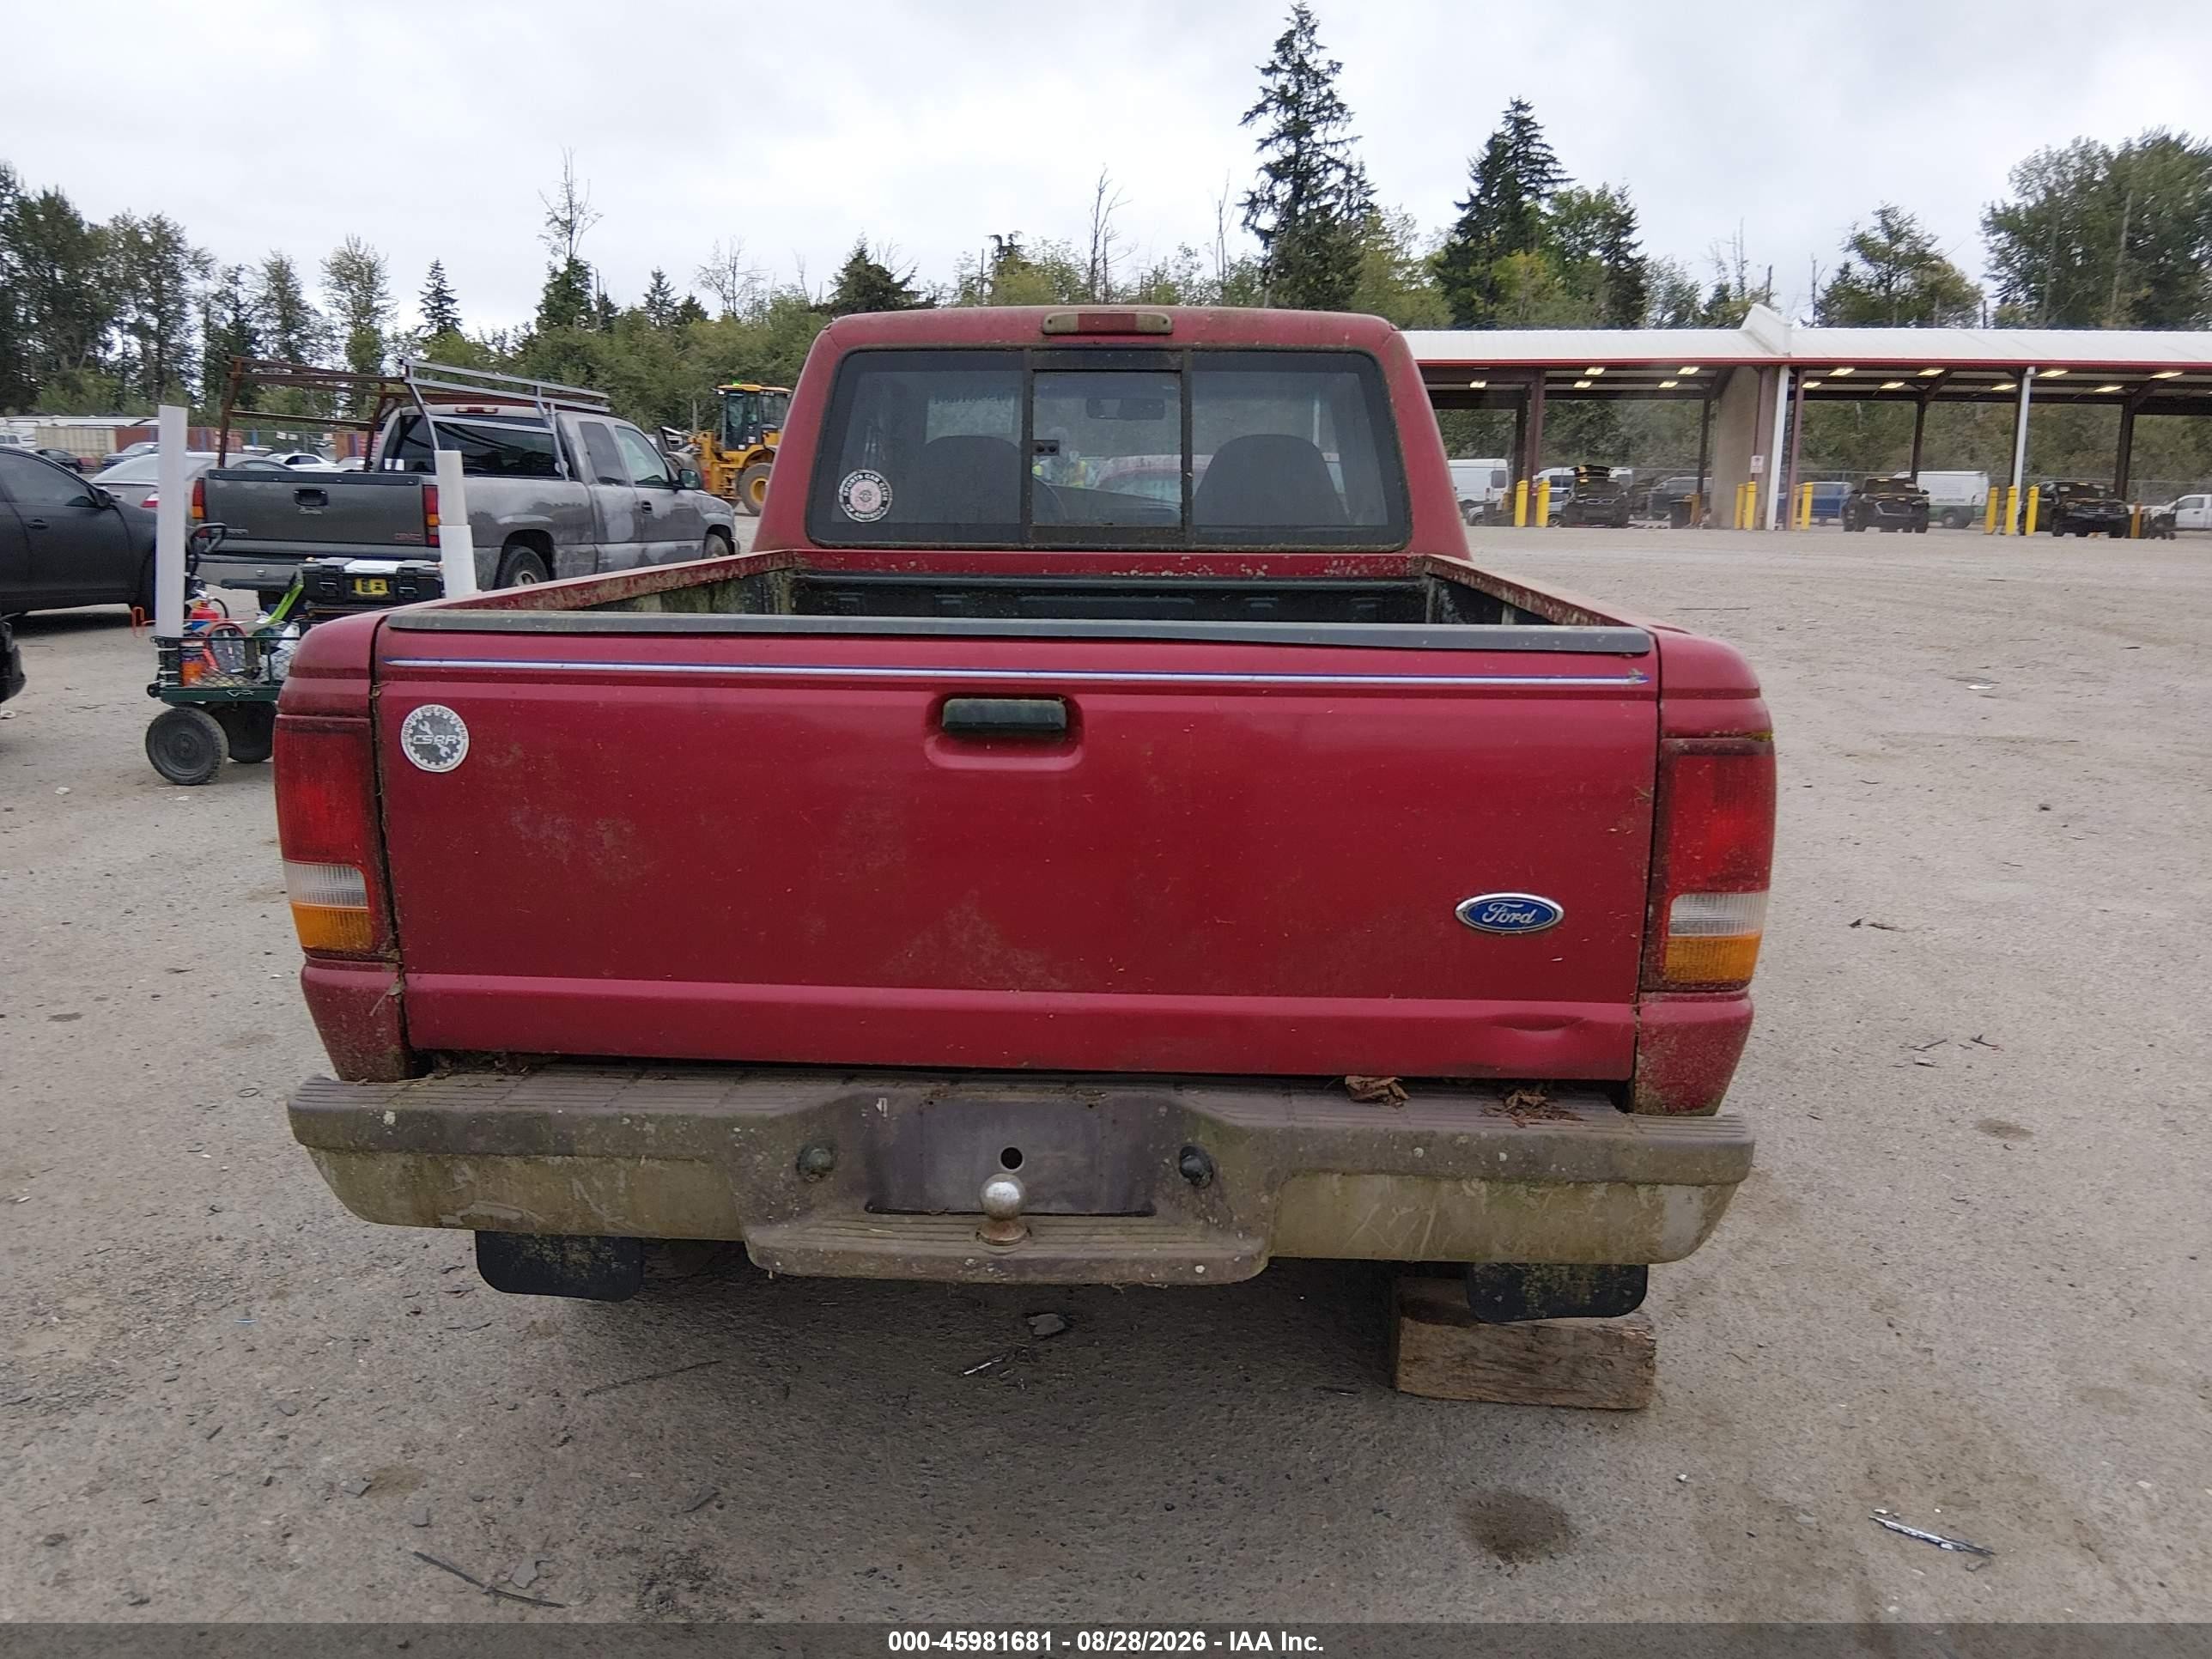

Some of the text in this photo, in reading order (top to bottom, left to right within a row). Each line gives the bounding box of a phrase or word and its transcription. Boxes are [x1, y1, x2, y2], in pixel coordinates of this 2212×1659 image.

[843, 473, 889, 501] SPORTS CAR CLUB
[1481, 902, 1538, 924] Ford
